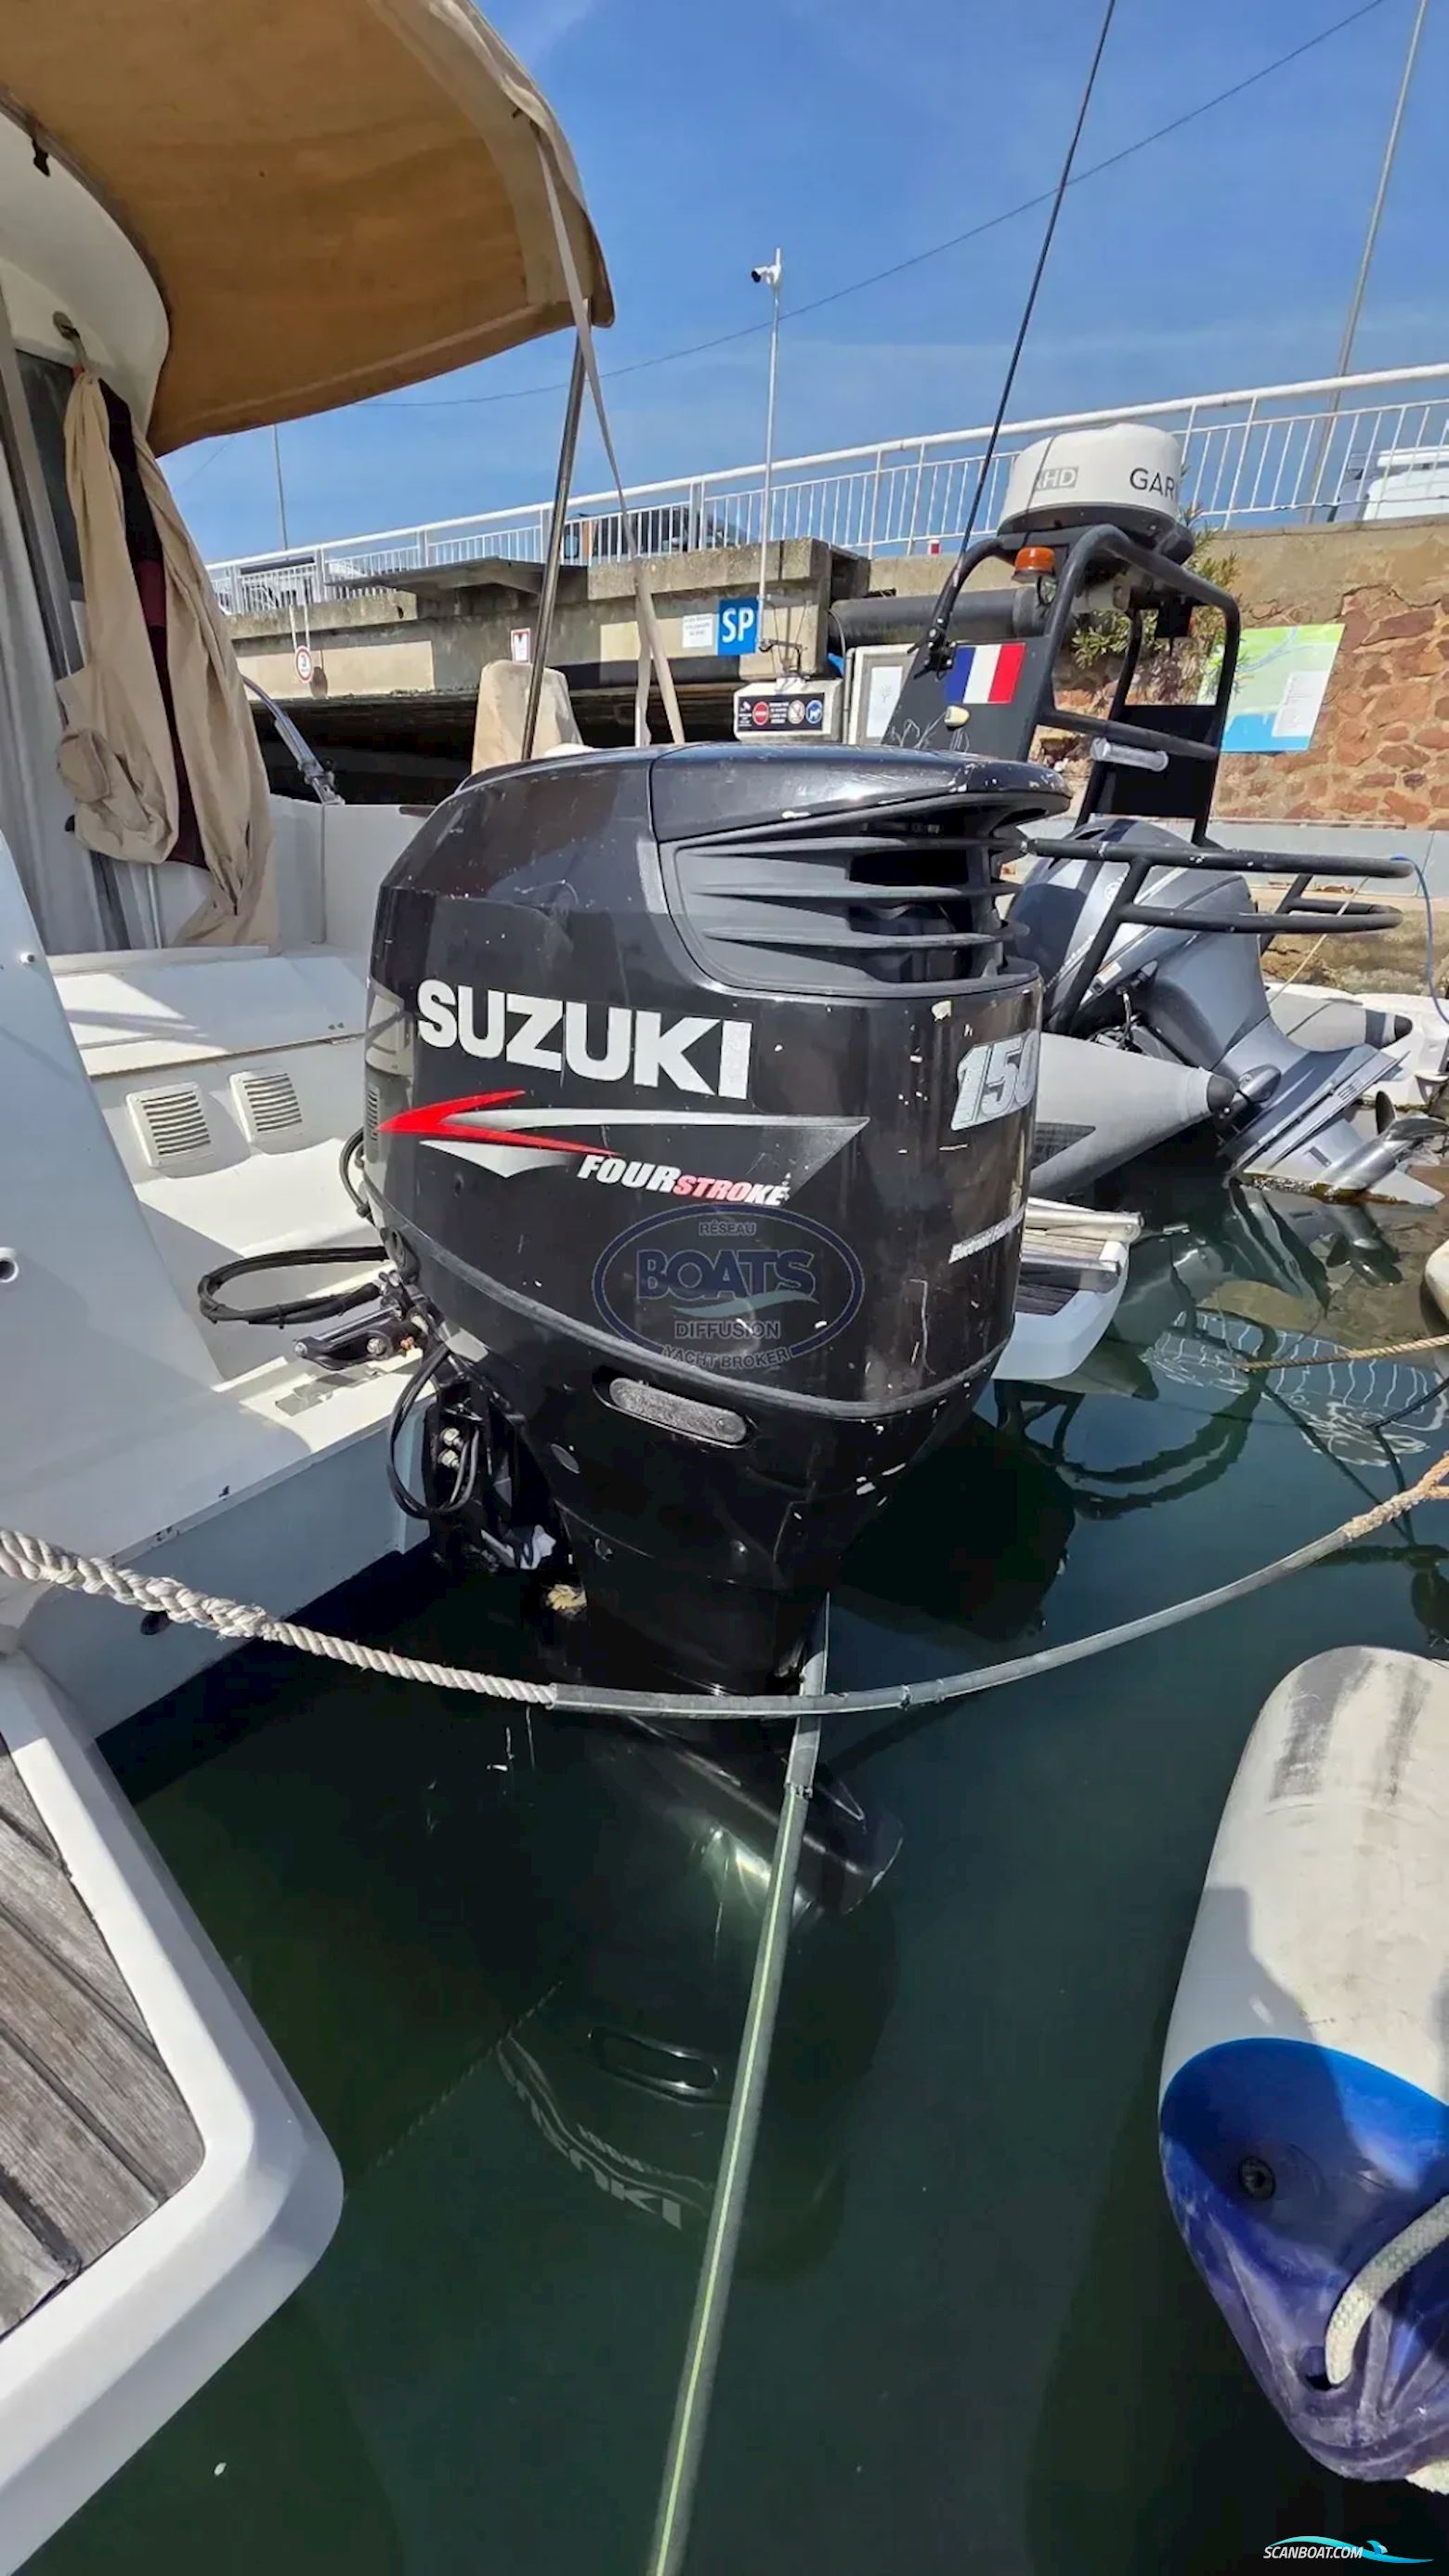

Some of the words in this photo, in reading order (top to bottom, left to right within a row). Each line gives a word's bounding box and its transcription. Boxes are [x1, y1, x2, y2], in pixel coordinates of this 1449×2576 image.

[1129, 467, 1180, 501] GAR
[722, 607, 754, 643] SP
[417, 979, 753, 1100] SUZUKI
[951, 1029, 1039, 1131] 150
